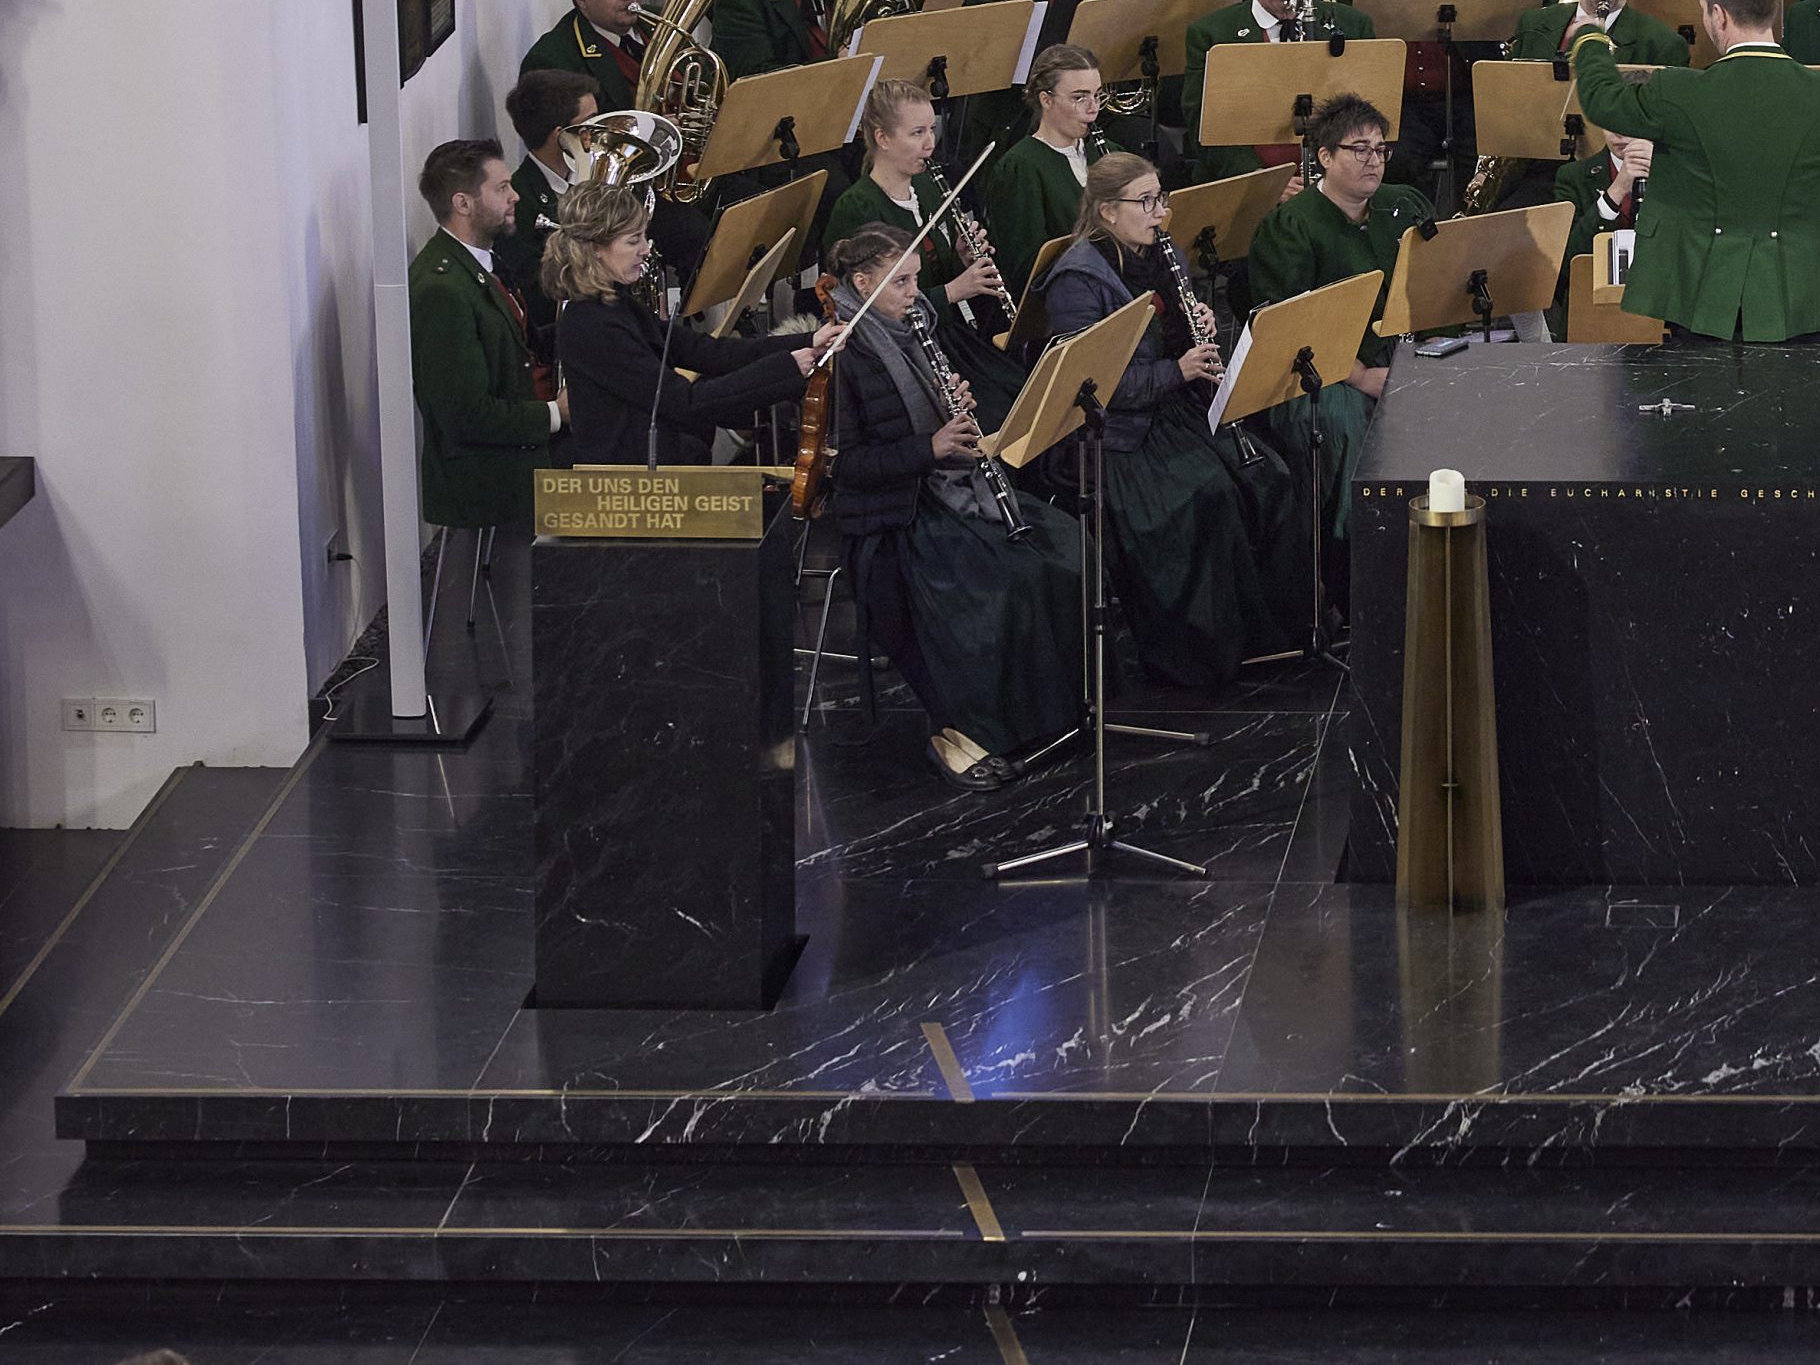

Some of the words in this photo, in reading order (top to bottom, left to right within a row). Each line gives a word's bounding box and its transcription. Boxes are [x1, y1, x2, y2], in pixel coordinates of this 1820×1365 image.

[543, 478, 582, 494] DER
[589, 478, 632, 494] UNS
[638, 478, 679, 494] DEN
[1363, 487, 1404, 497] DER
[1490, 488, 1528, 497] DIE
[1550, 488, 1718, 498] EUCHARISTIE
[597, 495, 689, 512] HEILIGEN
[694, 495, 753, 512] GEIST
[543, 513, 640, 529] GESANDT
[646, 513, 685, 530] HAT
